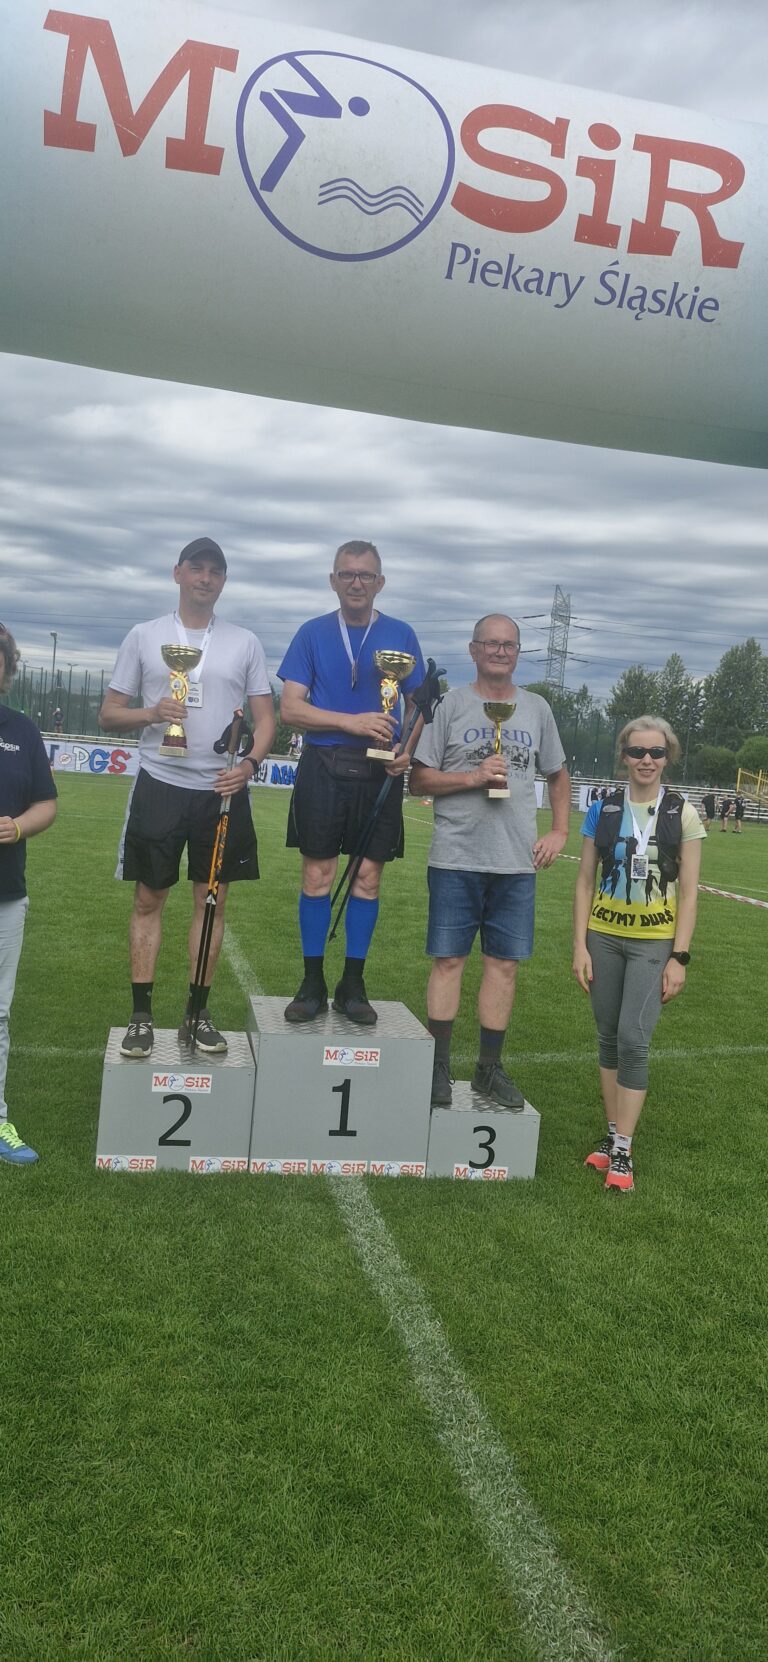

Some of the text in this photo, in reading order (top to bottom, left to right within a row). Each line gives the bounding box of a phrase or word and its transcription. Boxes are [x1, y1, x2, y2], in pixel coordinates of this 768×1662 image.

[444, 242, 720, 323] Piekary Śląskie
[73, 746, 132, 775] PGS
[463, 728, 532, 747] OHRID
[158, 1094, 193, 1147] 2
[328, 1079, 358, 1137] 1
[469, 1126, 496, 1169] 3
